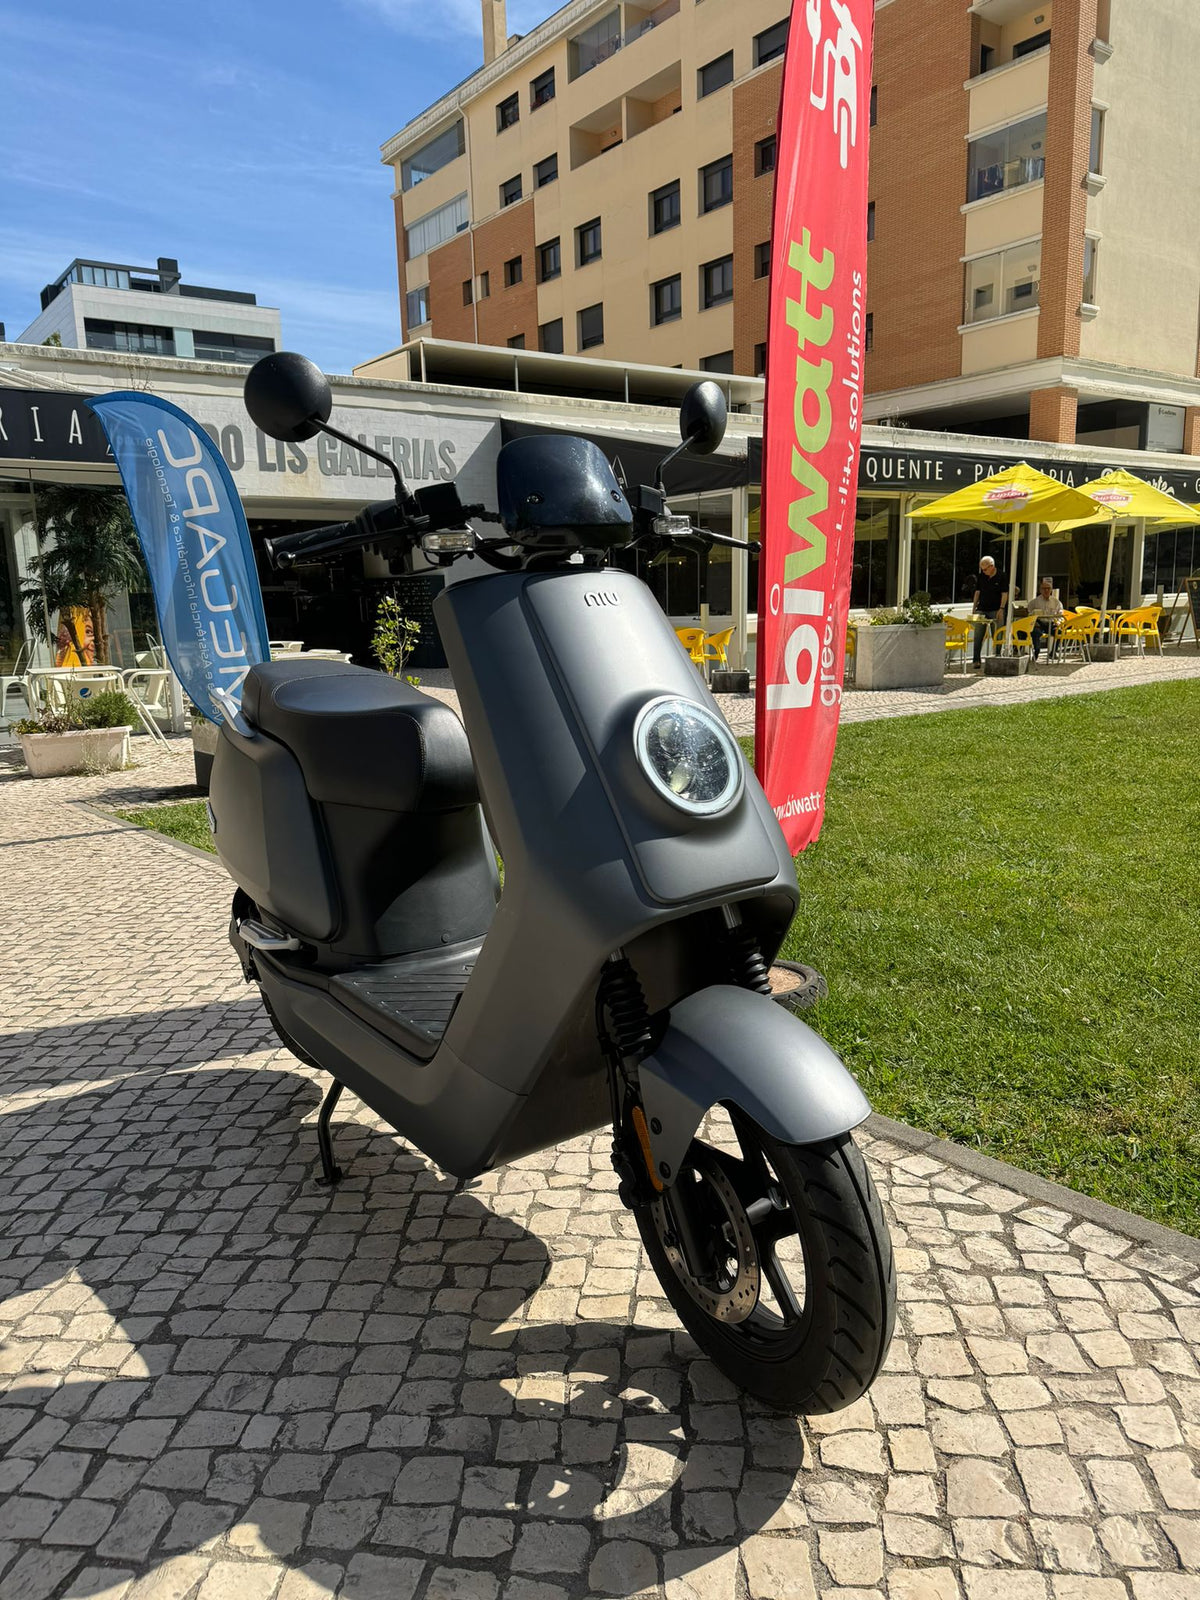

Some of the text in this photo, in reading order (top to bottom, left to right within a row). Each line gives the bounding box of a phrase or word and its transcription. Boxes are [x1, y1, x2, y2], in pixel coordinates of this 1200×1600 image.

[842, 270, 862, 433] solutions
[255, 426, 308, 475] LIS
[317, 432, 457, 481] GALERIAS
[766, 226, 835, 711] biwatt
[866, 456, 943, 482] QUENTE
